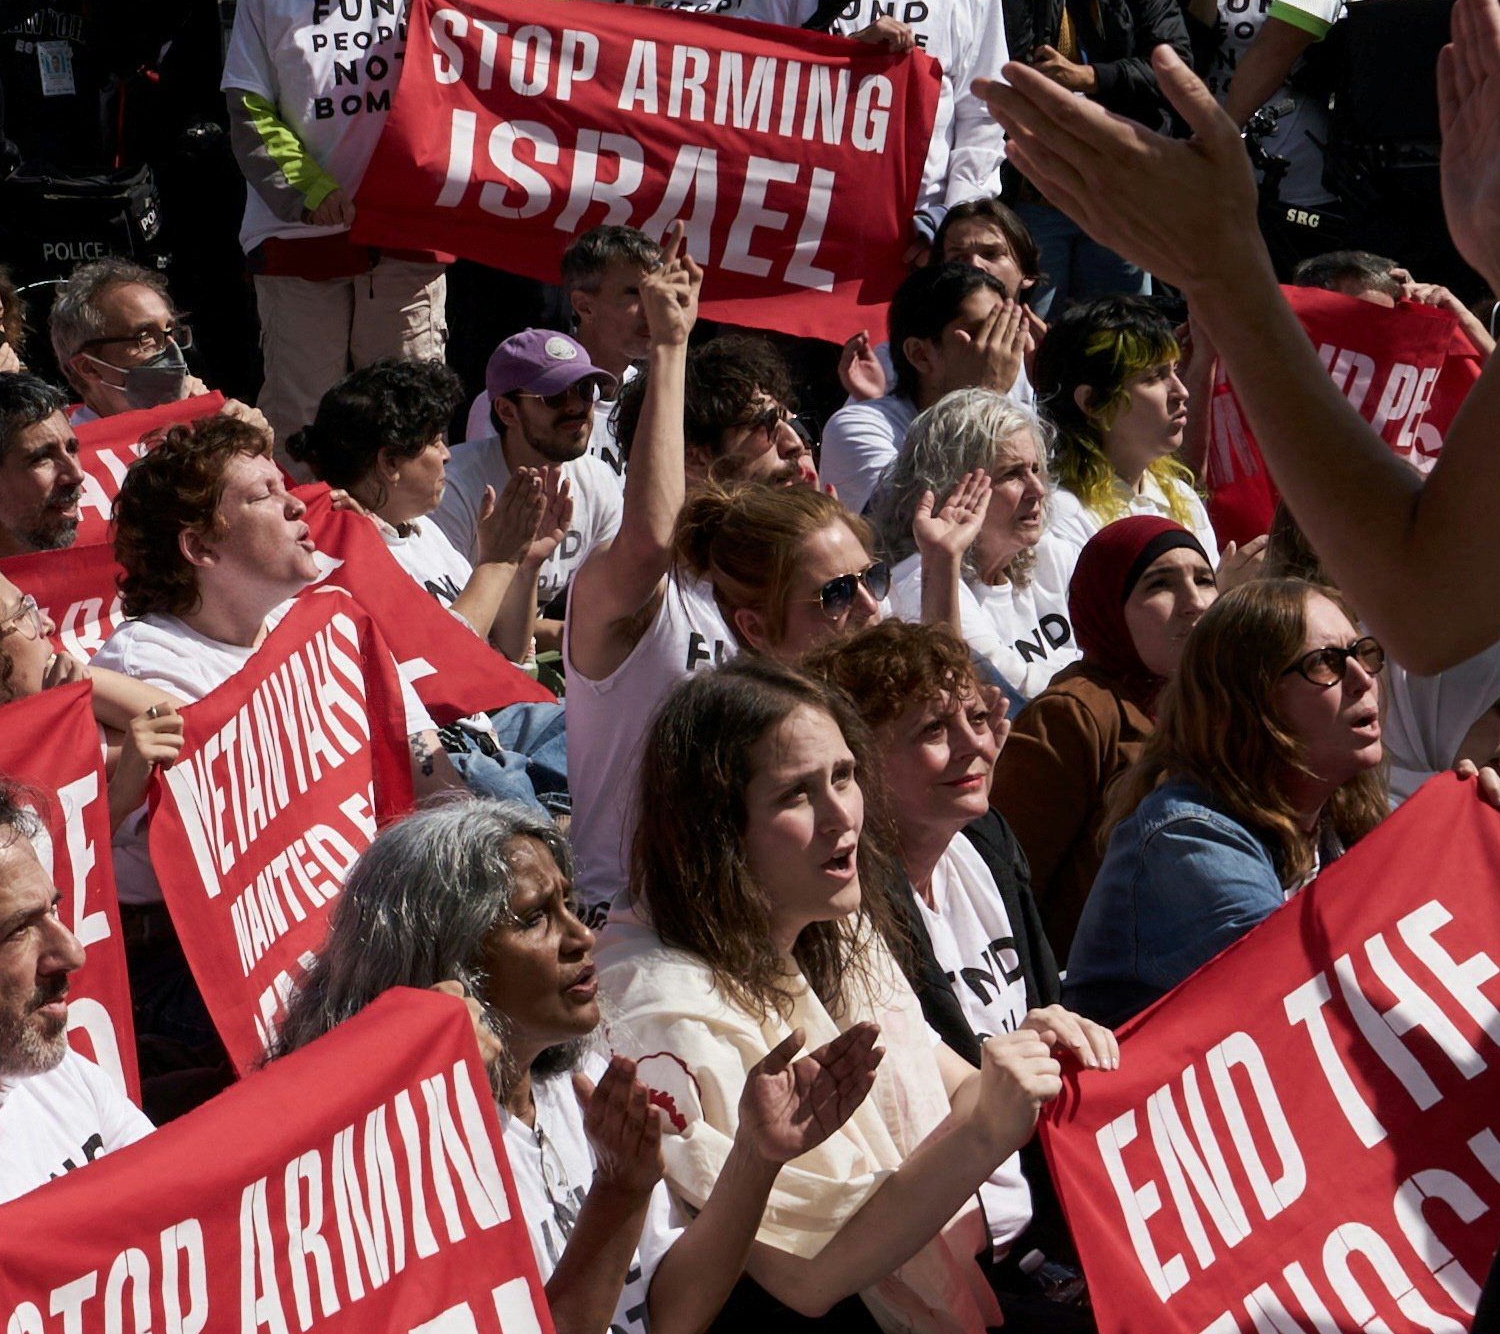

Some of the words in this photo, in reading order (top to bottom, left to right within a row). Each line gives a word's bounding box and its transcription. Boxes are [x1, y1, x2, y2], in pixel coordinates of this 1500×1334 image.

[839, 0, 930, 24] UND
[312, 23, 409, 53] PEOPL
[430, 7, 599, 102] STOP
[617, 39, 893, 155] ARMING
[315, 89, 391, 121] BOM
[434, 109, 838, 293] ISRAEL
[1286, 208, 1320, 228] SRG
[41, 242, 104, 263] POLICE
[1014, 613, 1072, 664] ND
[1095, 1030, 1307, 1304] END
